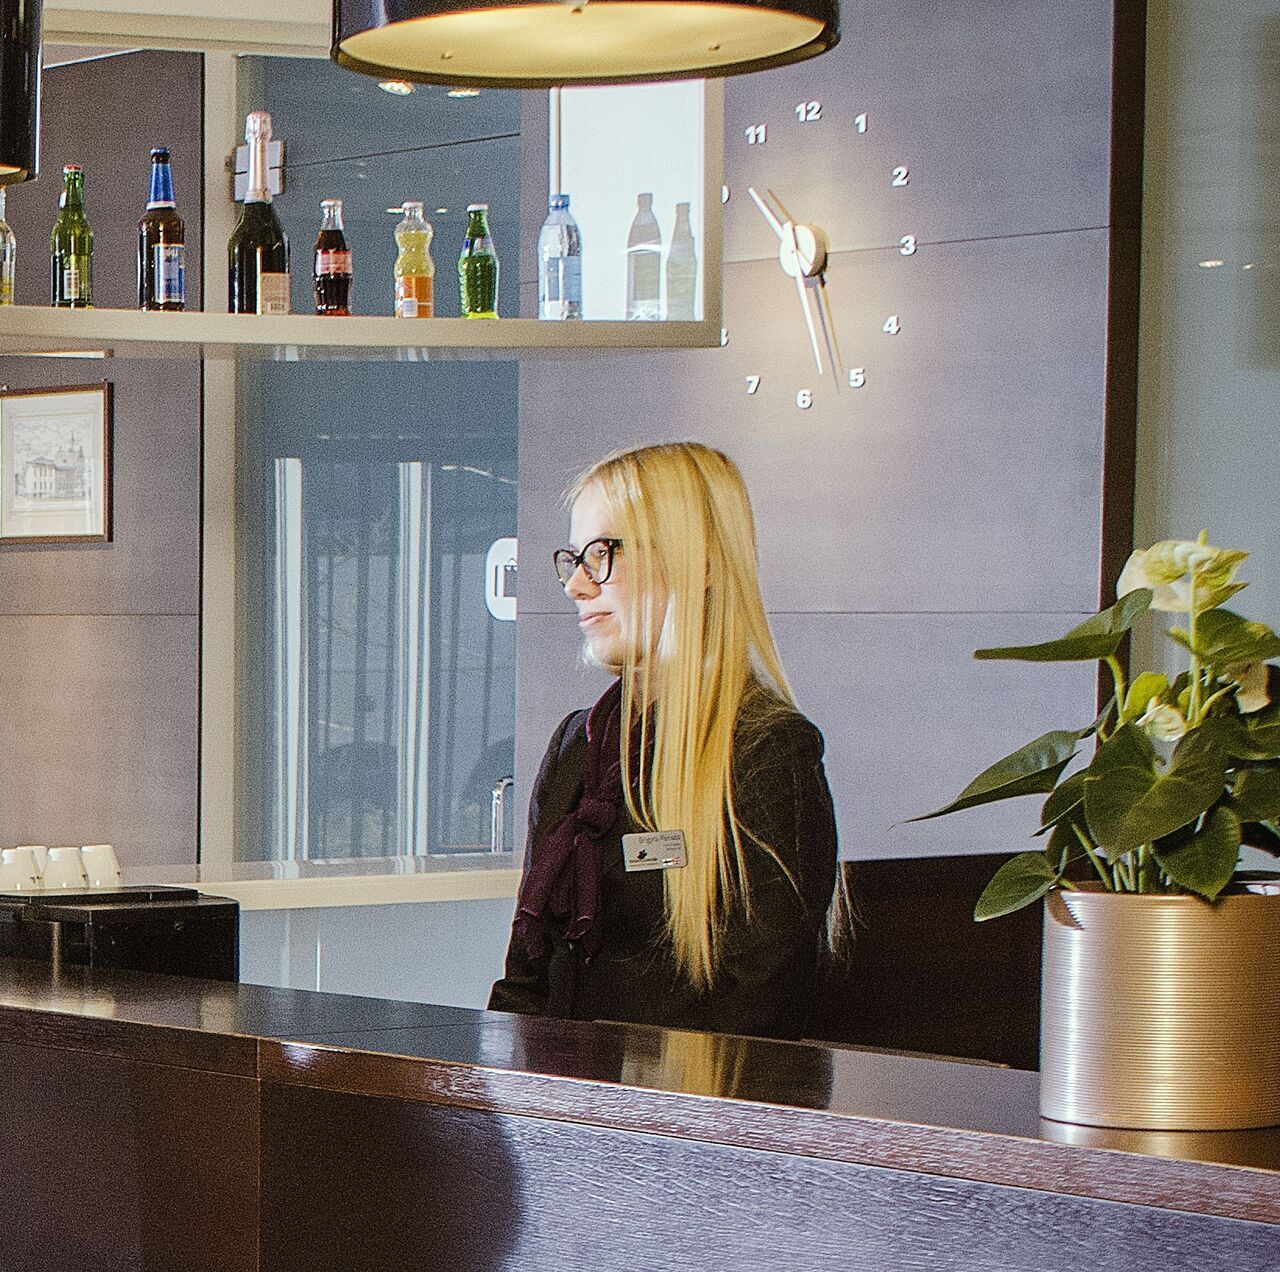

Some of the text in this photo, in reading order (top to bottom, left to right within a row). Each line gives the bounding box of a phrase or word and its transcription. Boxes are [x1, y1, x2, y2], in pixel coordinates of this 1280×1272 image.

[795, 101, 822, 123] 12
[854, 113, 868, 133] 1
[745, 124, 767, 145] 11
[891, 166, 910, 187] 2
[899, 235, 917, 256] 3
[882, 316, 901, 335] 4
[746, 375, 761, 394] 7
[848, 368, 865, 388] 5
[795, 389, 813, 409] 6
